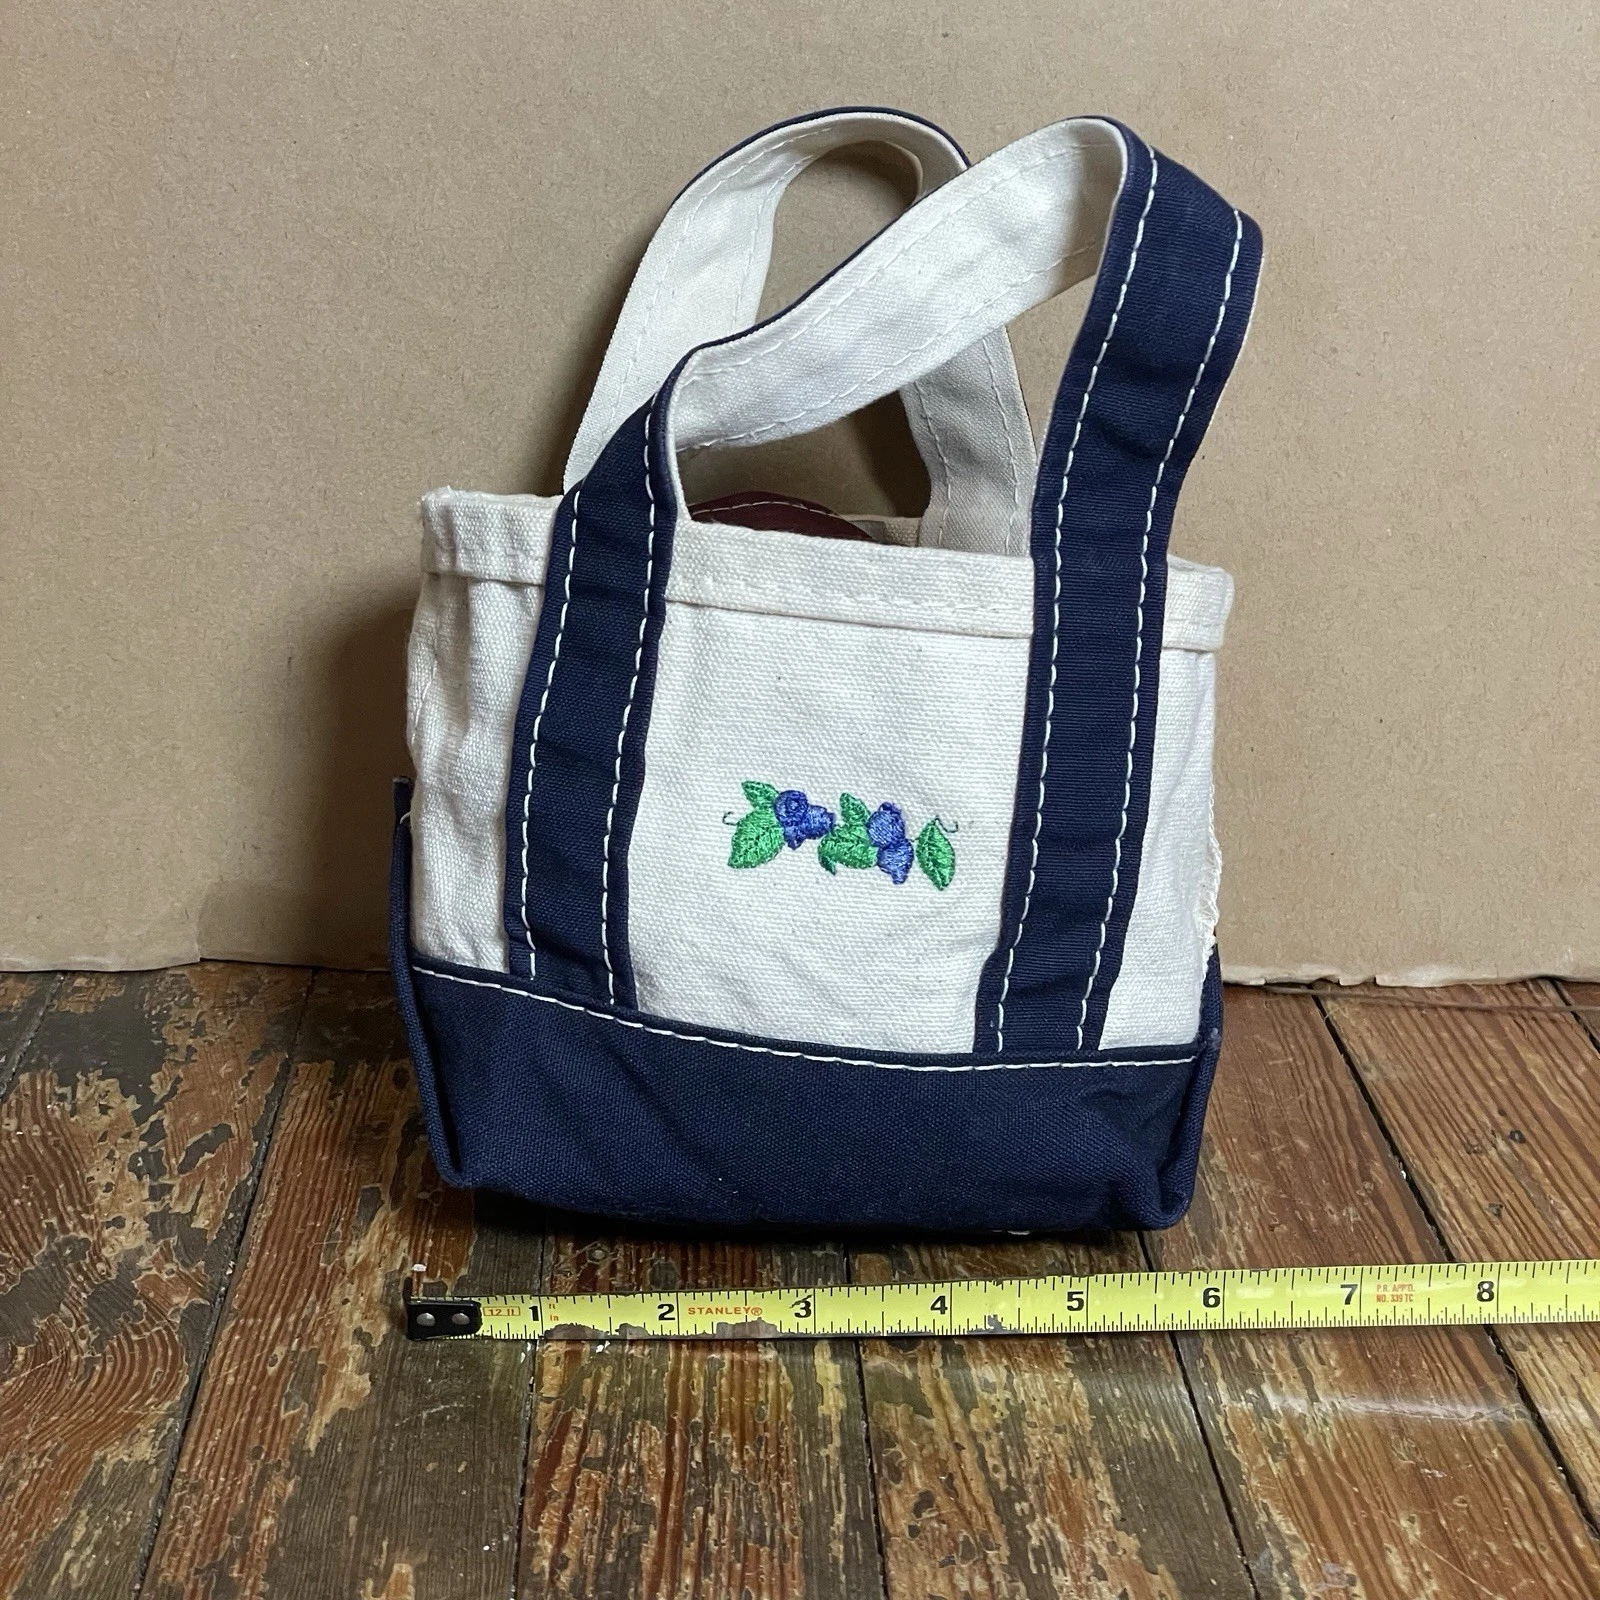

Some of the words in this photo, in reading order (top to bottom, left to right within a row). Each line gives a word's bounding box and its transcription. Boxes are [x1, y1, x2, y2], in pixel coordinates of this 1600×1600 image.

[1202, 1287, 1221, 1308] 6
[1340, 1284, 1359, 1305] 7
[1476, 1280, 1495, 1302] 8
[793, 1299, 812, 1318] 3
[930, 1295, 948, 1315] 4
[1066, 1291, 1085, 1312] 5
[528, 1305, 539, 1322] 1
[657, 1303, 676, 1321] 2
